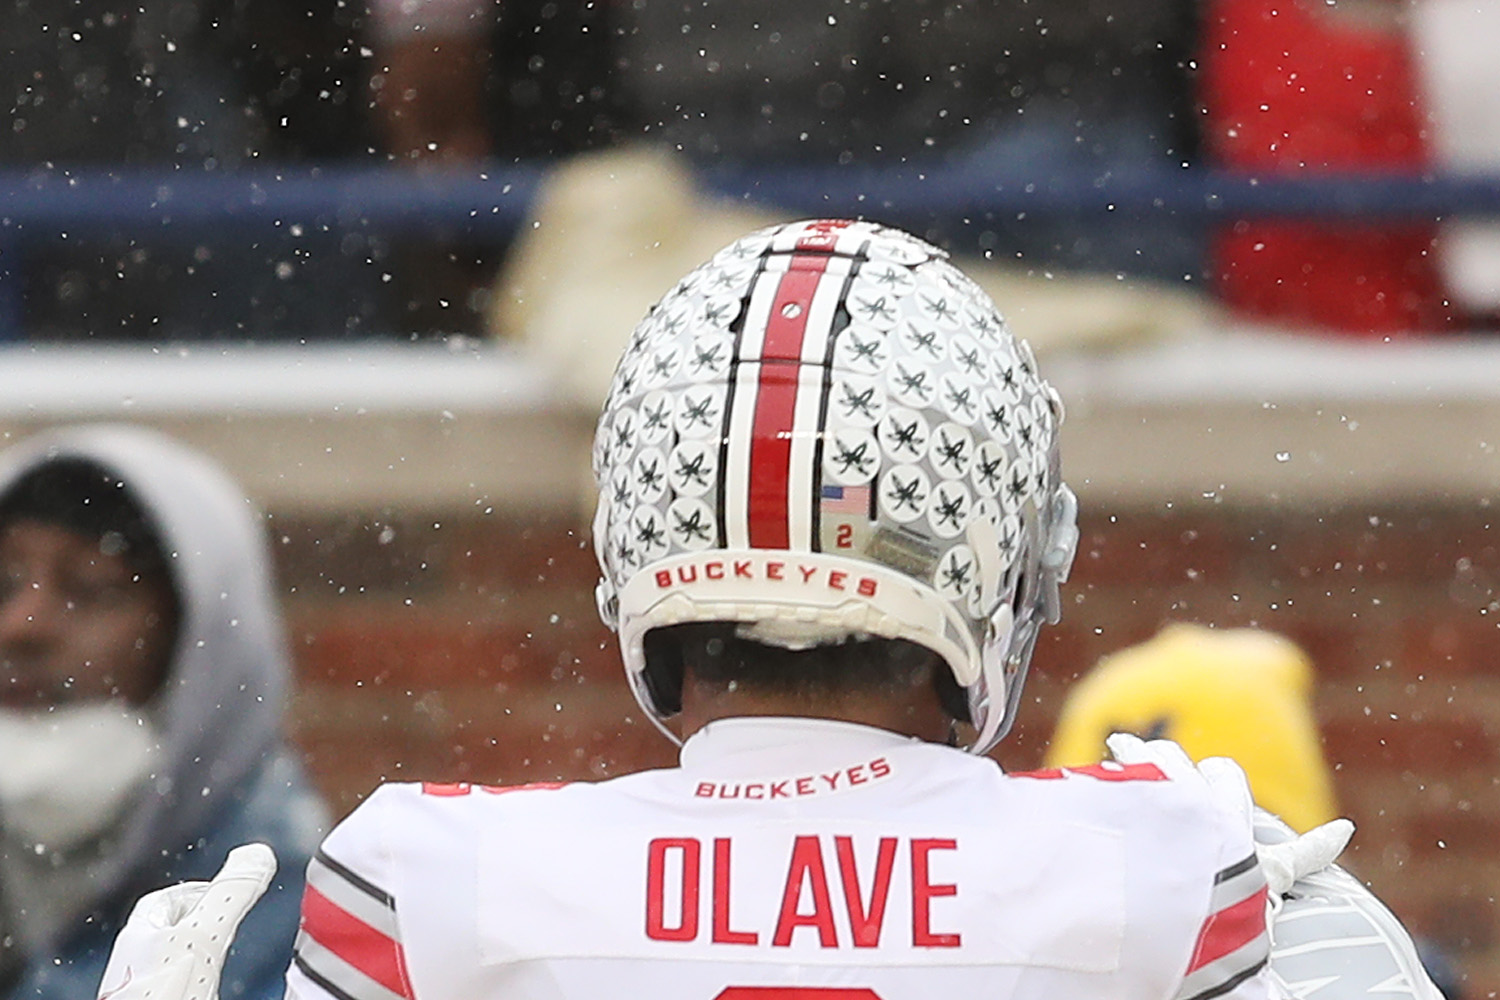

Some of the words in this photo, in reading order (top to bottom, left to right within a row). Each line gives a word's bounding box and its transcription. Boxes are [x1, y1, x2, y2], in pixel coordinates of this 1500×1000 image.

[836, 524, 853, 549] 2
[655, 560, 878, 598] BUCKEYES
[694, 757, 892, 800] BUCKEYES
[645, 834, 962, 949] OLAVE
